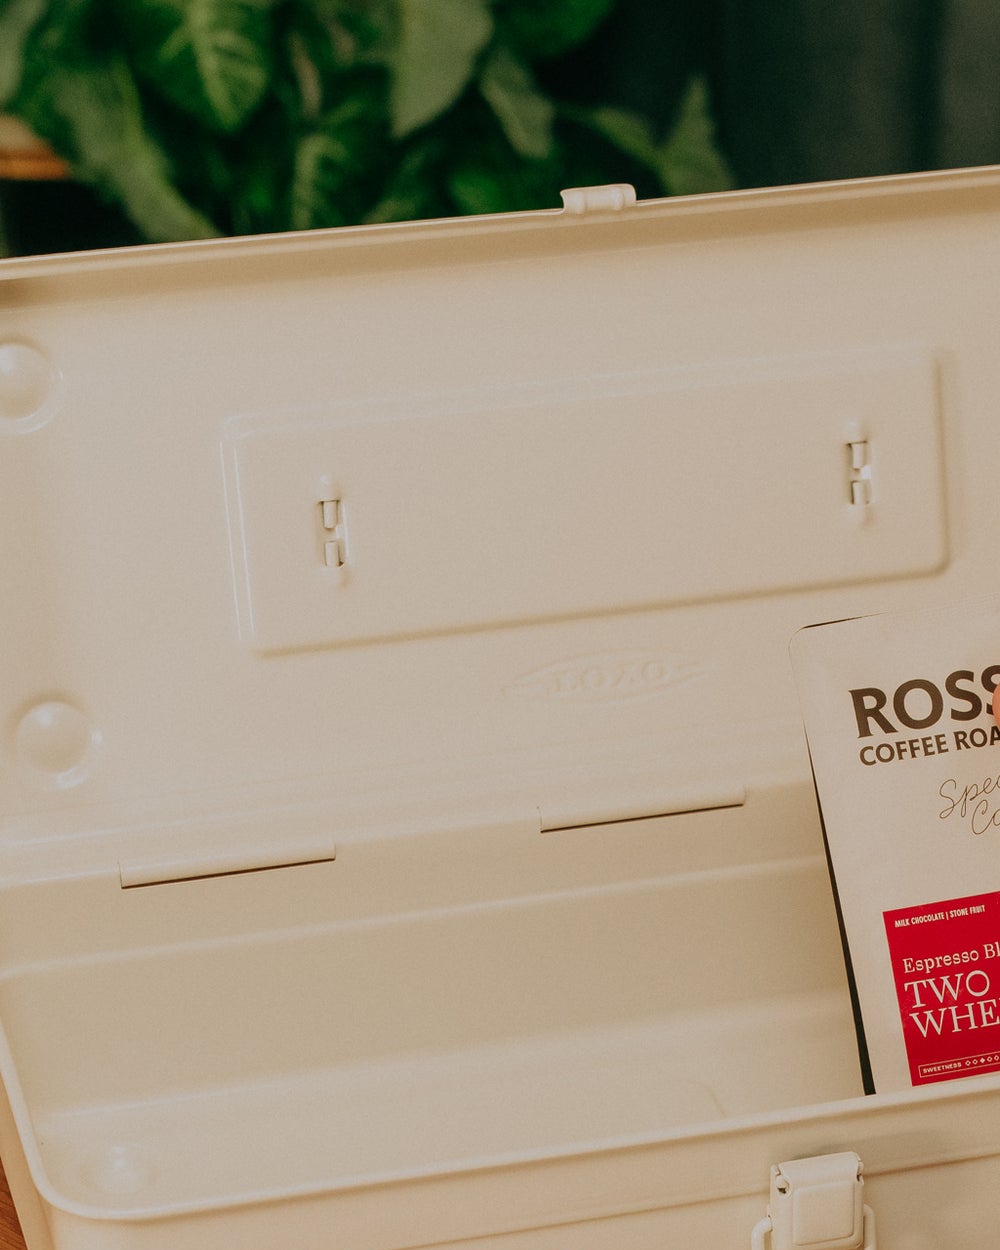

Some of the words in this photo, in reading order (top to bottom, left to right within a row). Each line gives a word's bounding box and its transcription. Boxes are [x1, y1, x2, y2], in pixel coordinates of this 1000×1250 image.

[859, 734, 949, 766] COFFEE
[894, 918, 910, 928] MILK
[911, 912, 945, 926] CHOCOLATE
[949, 907, 969, 918] STONE
[970, 905, 986, 915] FRUIT
[903, 949, 979, 974] Espresso
[904, 970, 990, 1009] TWO
[923, 1062, 962, 1074] SWEETNESS
